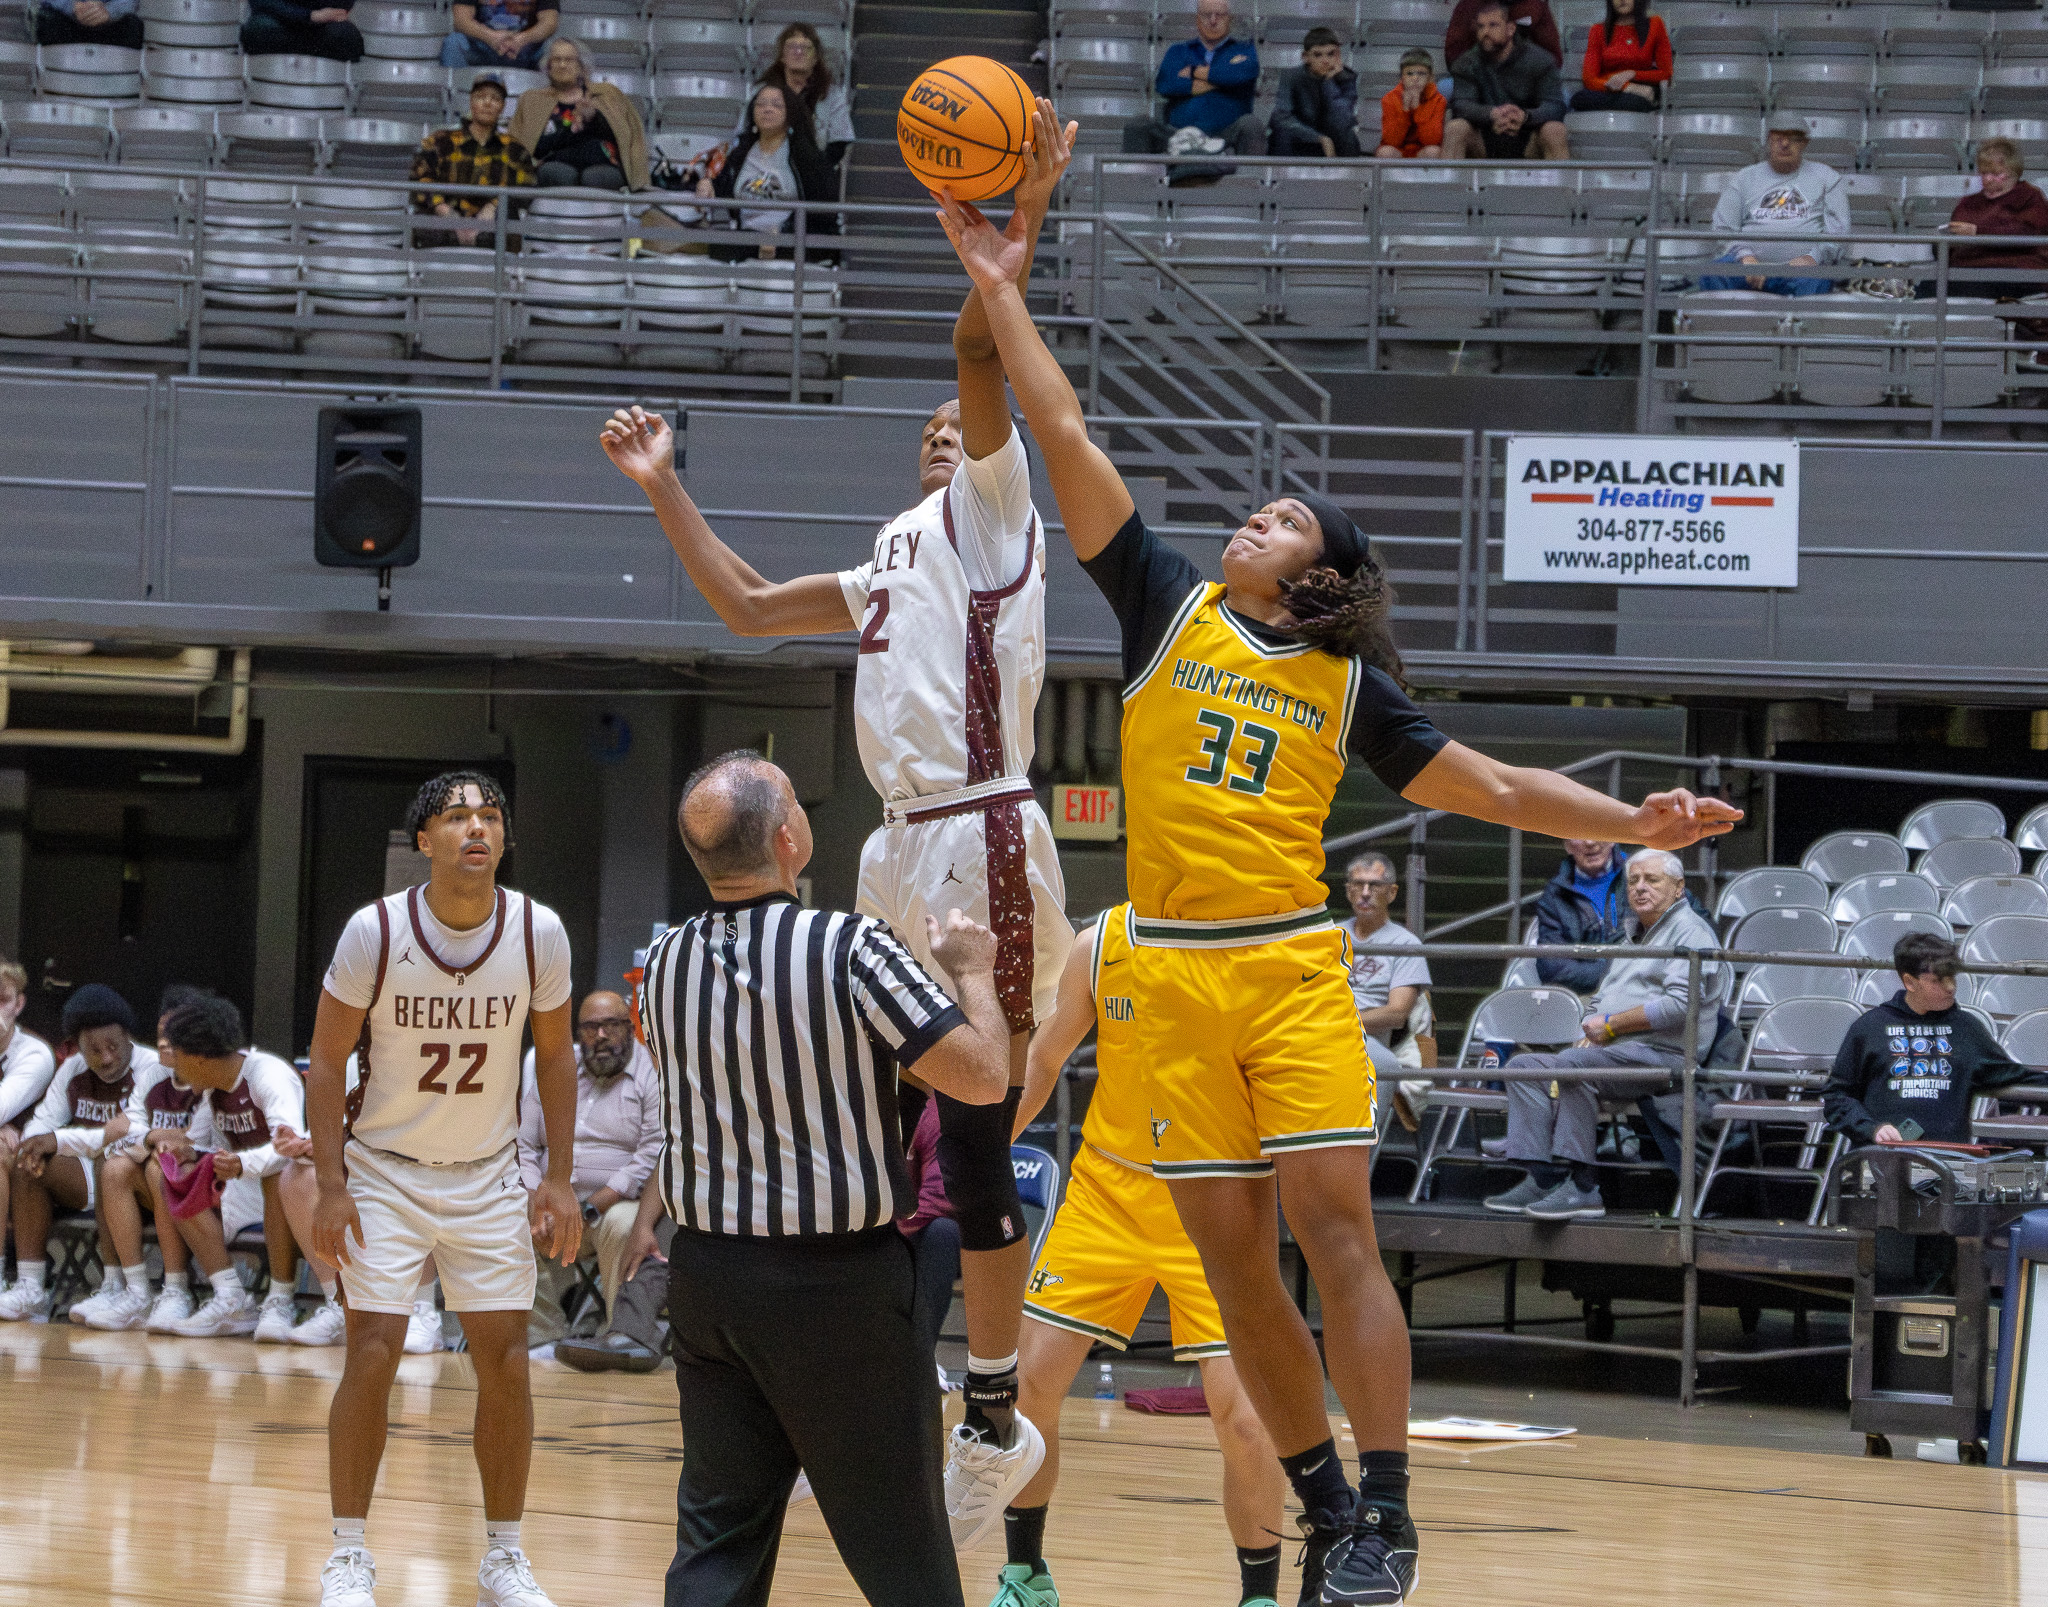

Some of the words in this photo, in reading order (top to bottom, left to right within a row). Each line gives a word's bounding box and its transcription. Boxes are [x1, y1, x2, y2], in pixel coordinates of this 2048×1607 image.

[910, 84, 968, 122] NCAA
[1521, 459, 1785, 487] APPALACHIAN
[1598, 487, 1705, 513] Heating
[1577, 517, 1726, 543] 304-877-5566
[1544, 548, 1750, 574] www.appheat.com
[1171, 658, 1327, 735] HUNTINGTON
[1185, 707, 1280, 797] 33
[1065, 788, 1109, 823] EXIT
[395, 995, 517, 1030] BECKLEY
[1887, 1026, 1905, 1036] LIFE
[418, 1043, 488, 1095] 22
[1890, 1080, 1901, 1090] OF
[1902, 1079, 1952, 1090] IMPORTANT
[1902, 1088, 1939, 1099] CHOICES
[1012, 1161, 1043, 1179] CH
